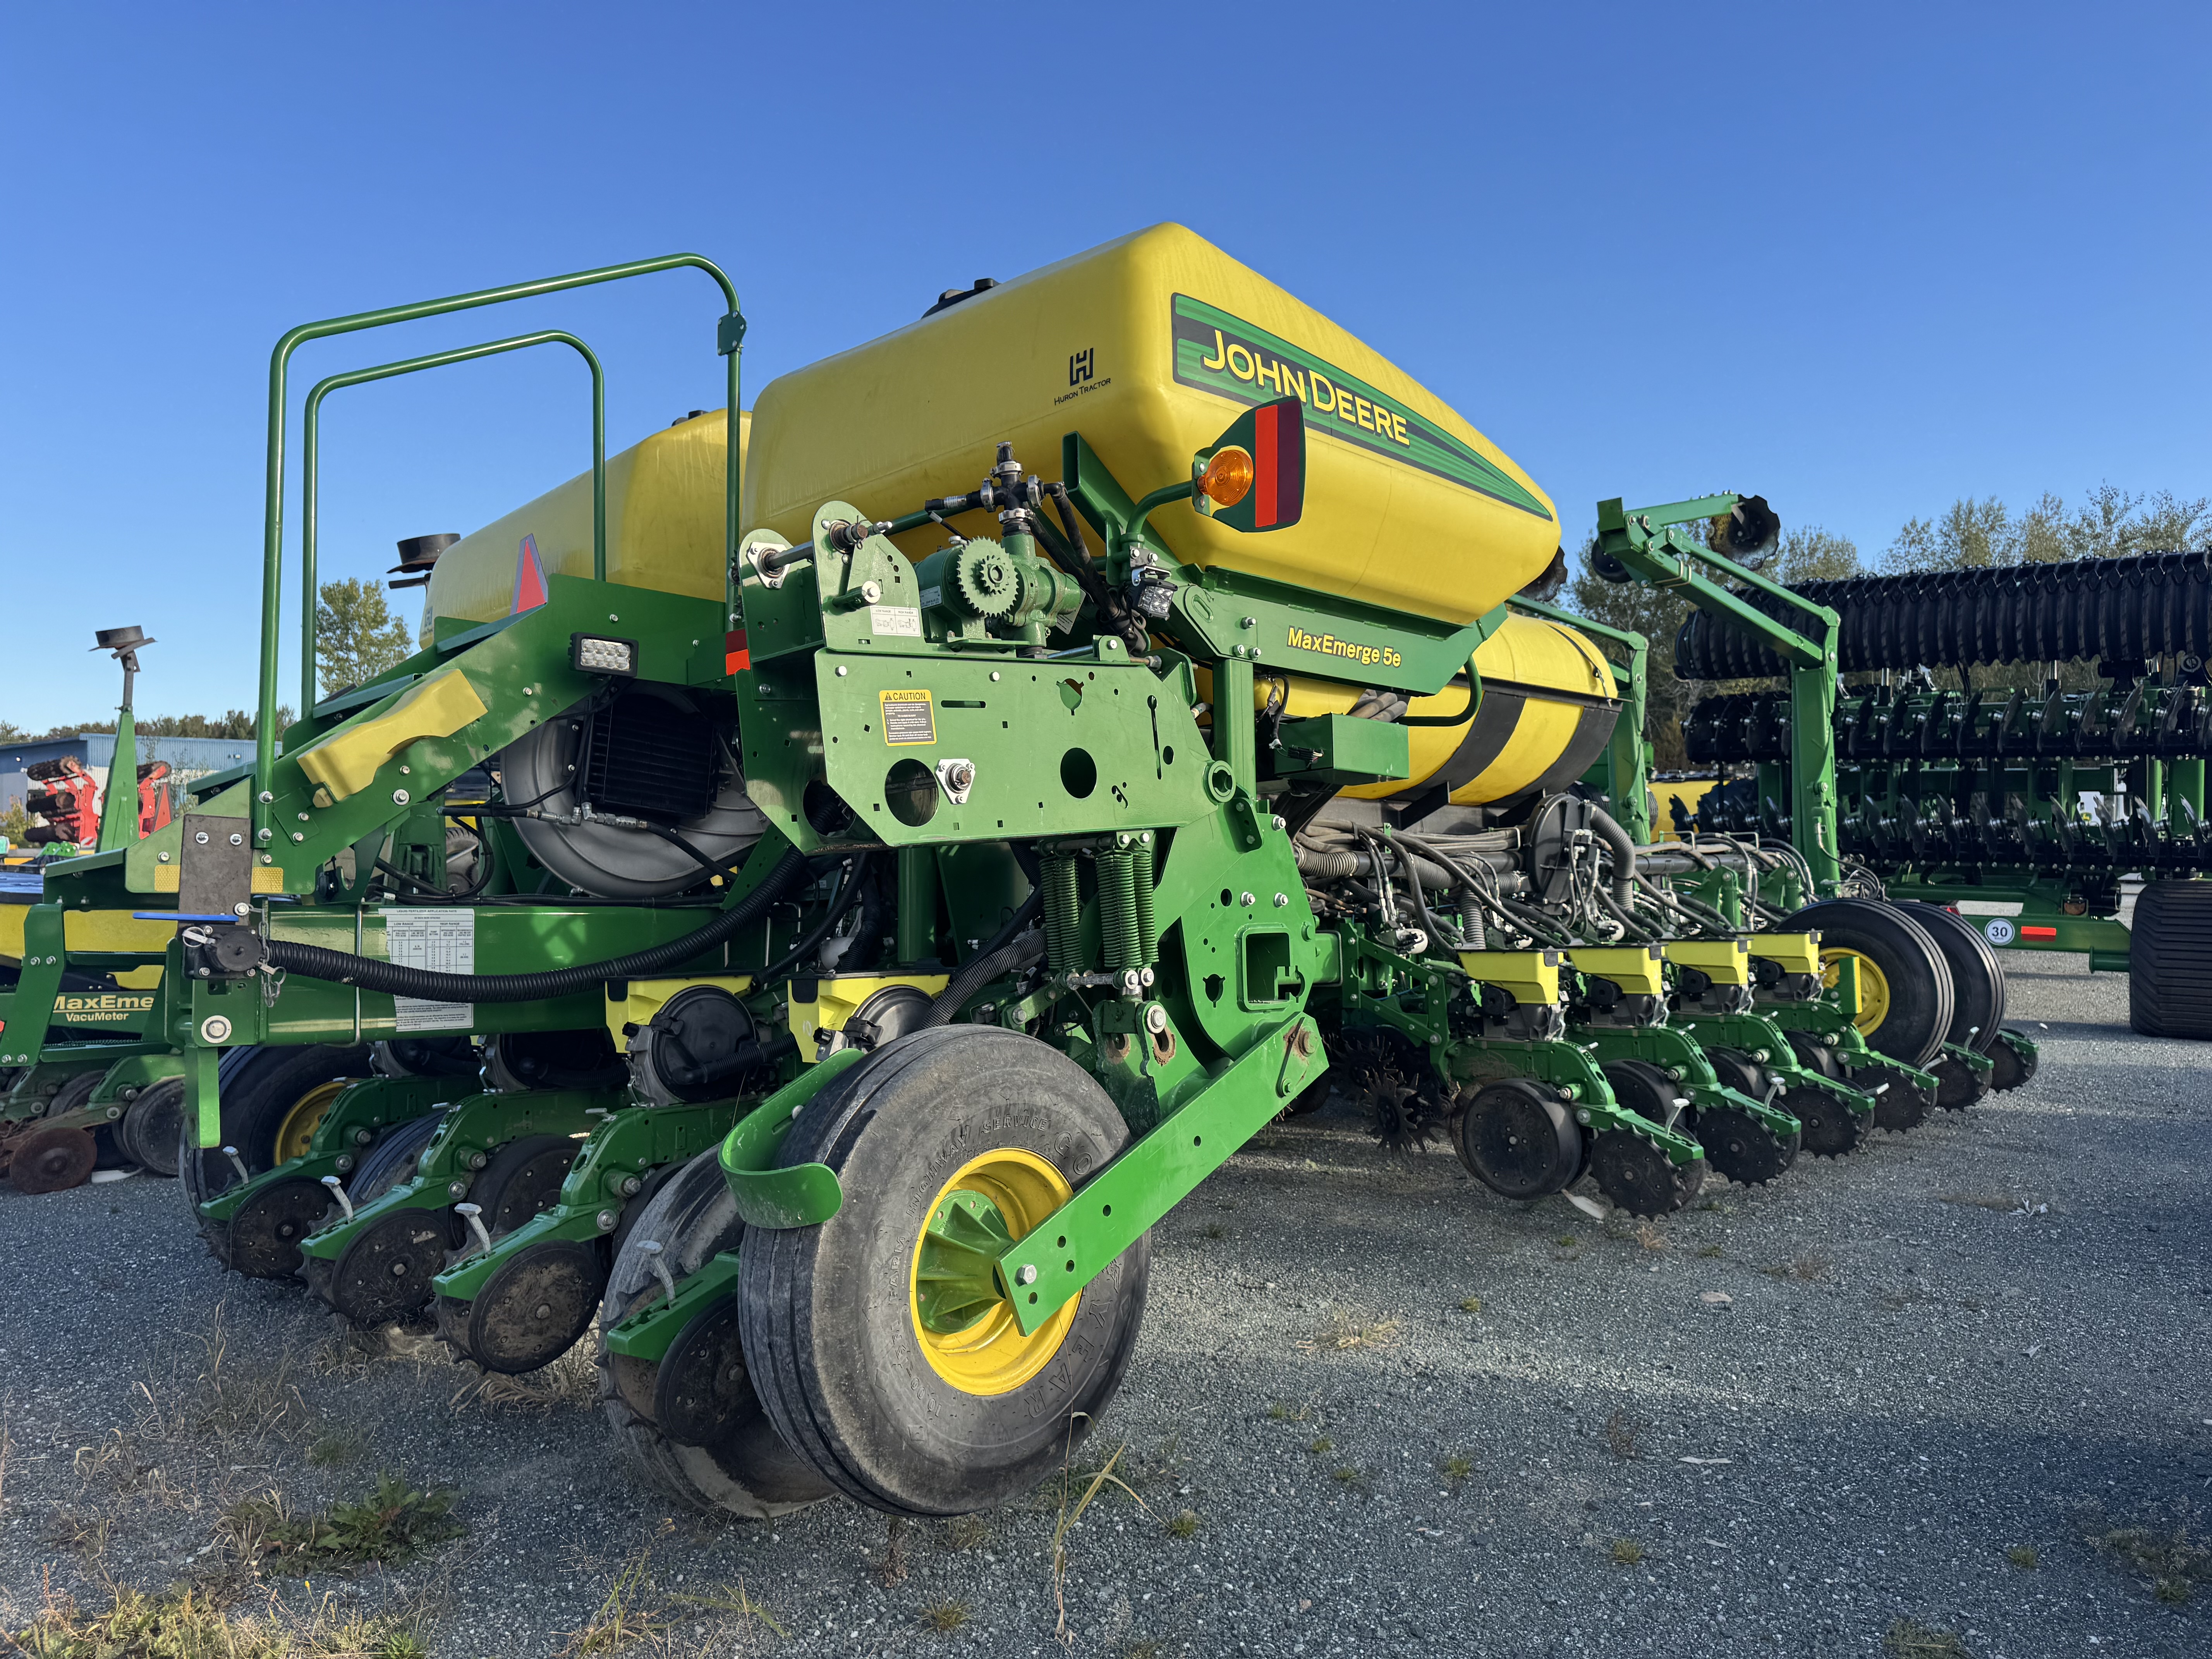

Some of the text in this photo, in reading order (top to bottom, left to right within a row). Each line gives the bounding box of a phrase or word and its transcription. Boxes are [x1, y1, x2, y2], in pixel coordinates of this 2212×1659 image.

[1054, 378, 1111, 406] HURON TRACTOR
[1203, 330, 1410, 446] JOHN DEERE
[1288, 627, 1401, 667] MaxEmerge 5e
[1992, 927, 2008, 937] 30
[54, 995, 154, 1010] MaxEme
[66, 1013, 129, 1022] VacuMeter
[982, 1114, 1049, 1133] SERVICE
[888, 1236, 906, 1302] FARM
